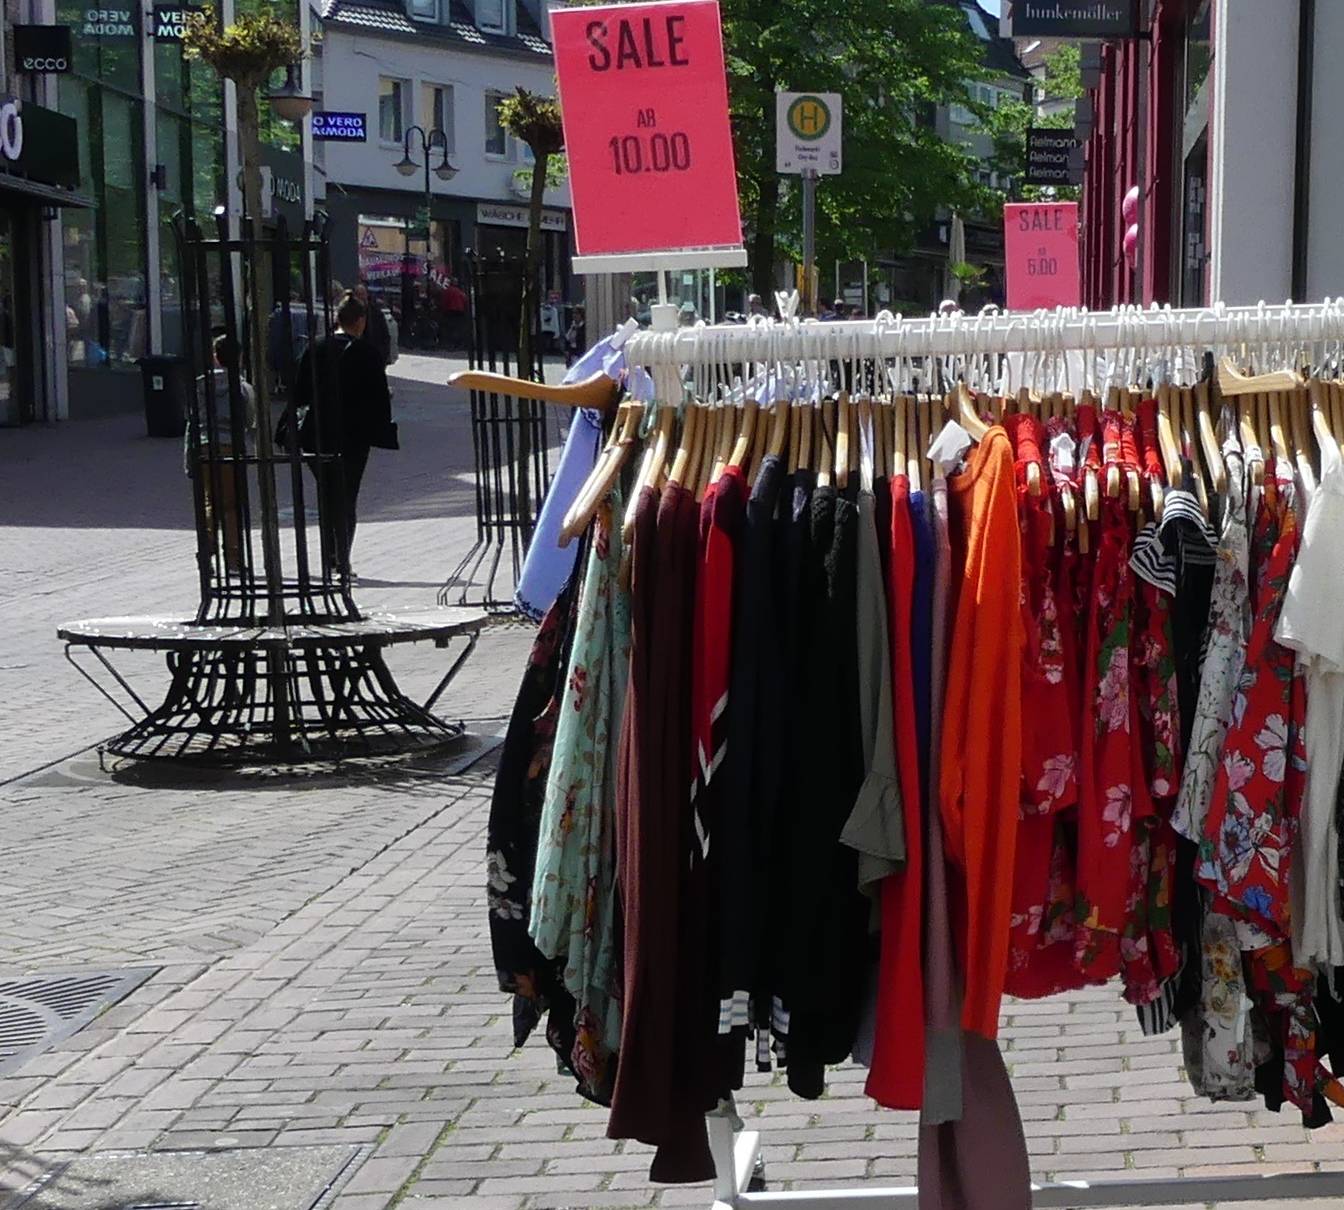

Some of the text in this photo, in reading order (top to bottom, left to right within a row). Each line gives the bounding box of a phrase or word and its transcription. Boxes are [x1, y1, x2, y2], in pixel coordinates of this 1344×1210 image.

[586, 15, 689, 72] SALE
[23, 58, 68, 70] ecco
[328, 117, 363, 127] VERO
[637, 108, 656, 128] AB
[609, 132, 691, 175] 10.00
[1019, 209, 1064, 232] SALE
[422, 262, 451, 289] SALE
